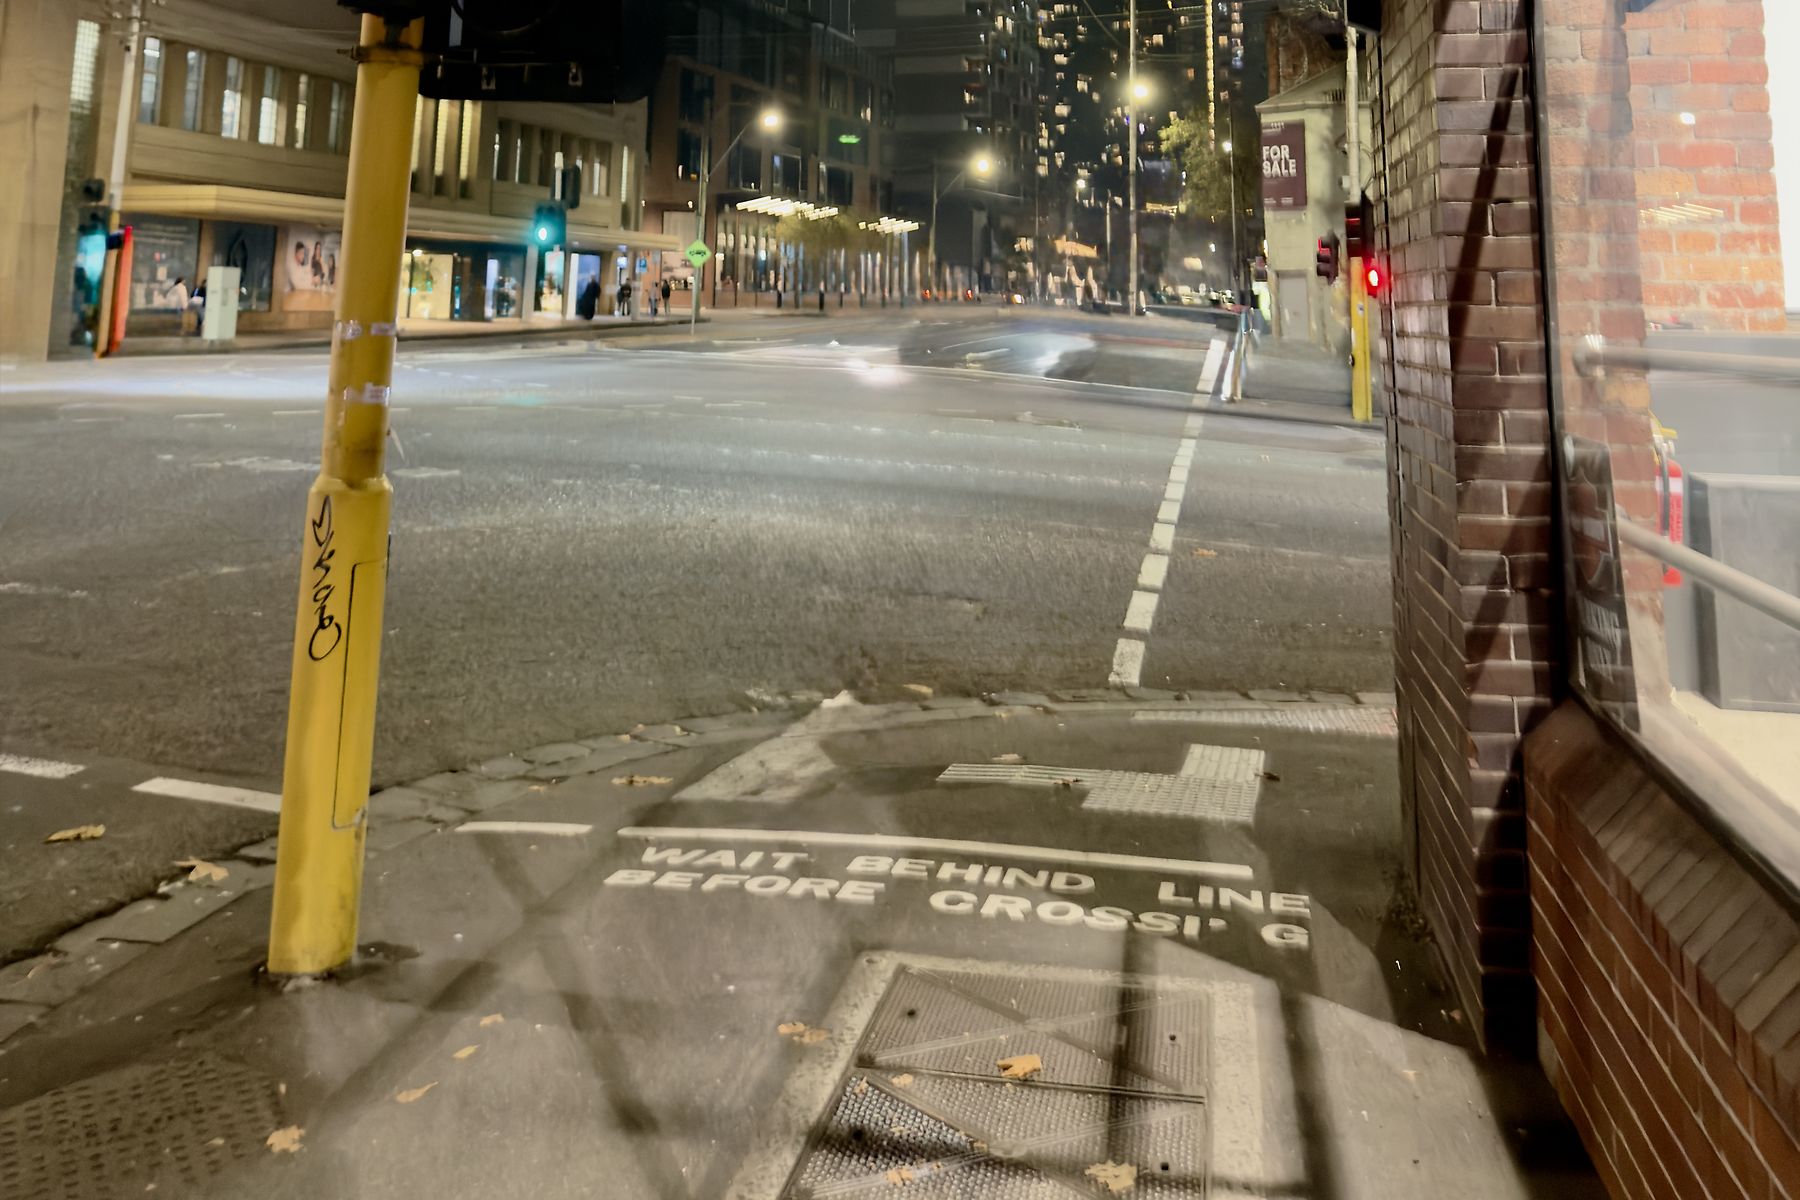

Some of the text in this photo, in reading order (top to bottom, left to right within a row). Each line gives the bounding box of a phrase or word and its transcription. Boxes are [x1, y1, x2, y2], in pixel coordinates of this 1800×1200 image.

[1262, 144, 1290, 161] FOR
[1262, 159, 1297, 178] SALE
[641, 846, 1311, 918] WAIT BEHIND LINE
[603, 869, 1310, 947] BEFORE CROSSIG
